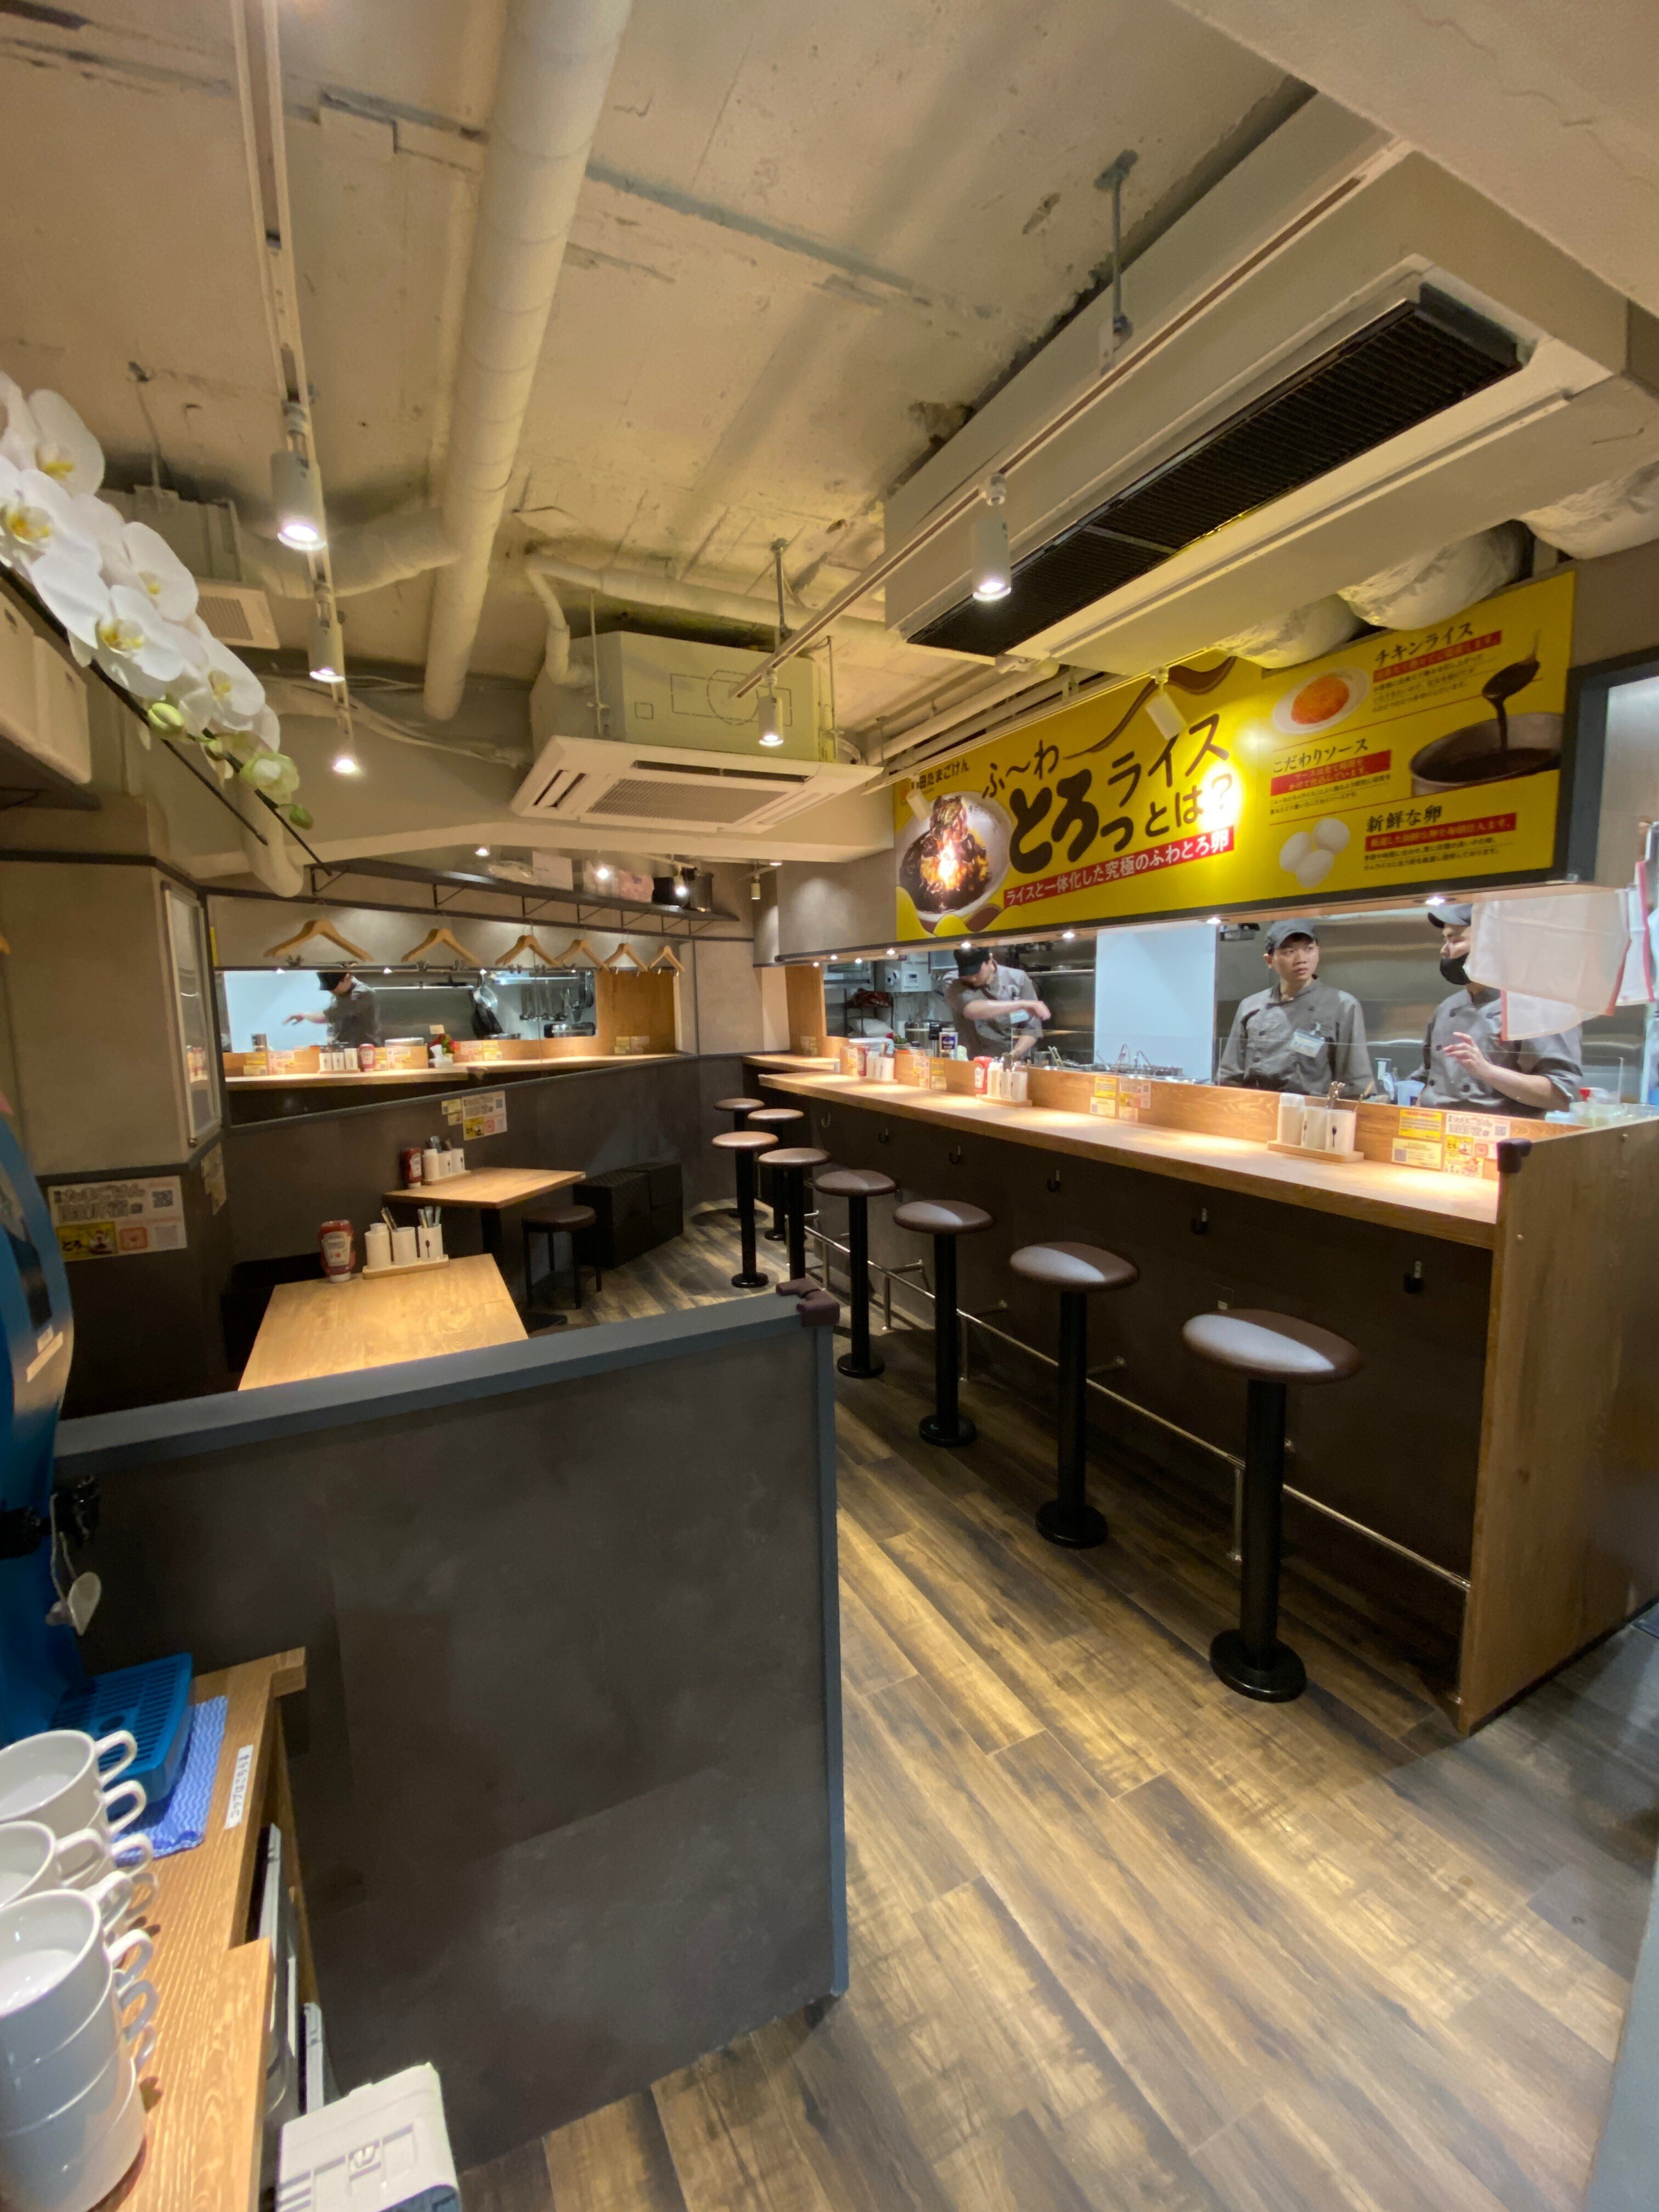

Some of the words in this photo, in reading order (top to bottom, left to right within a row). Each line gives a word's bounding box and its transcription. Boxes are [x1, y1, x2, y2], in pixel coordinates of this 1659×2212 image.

[1375, 622, 1474, 668] チキンライス
[911, 758, 969, 789] 田たまごけん
[1107, 714, 1229, 806] ライス
[1273, 738, 1369, 773] こだわりソース
[1366, 805, 1442, 833] 新鮮な卵
[1006, 829, 1229, 906] ライスと一体化した究極のふわとろ卵
